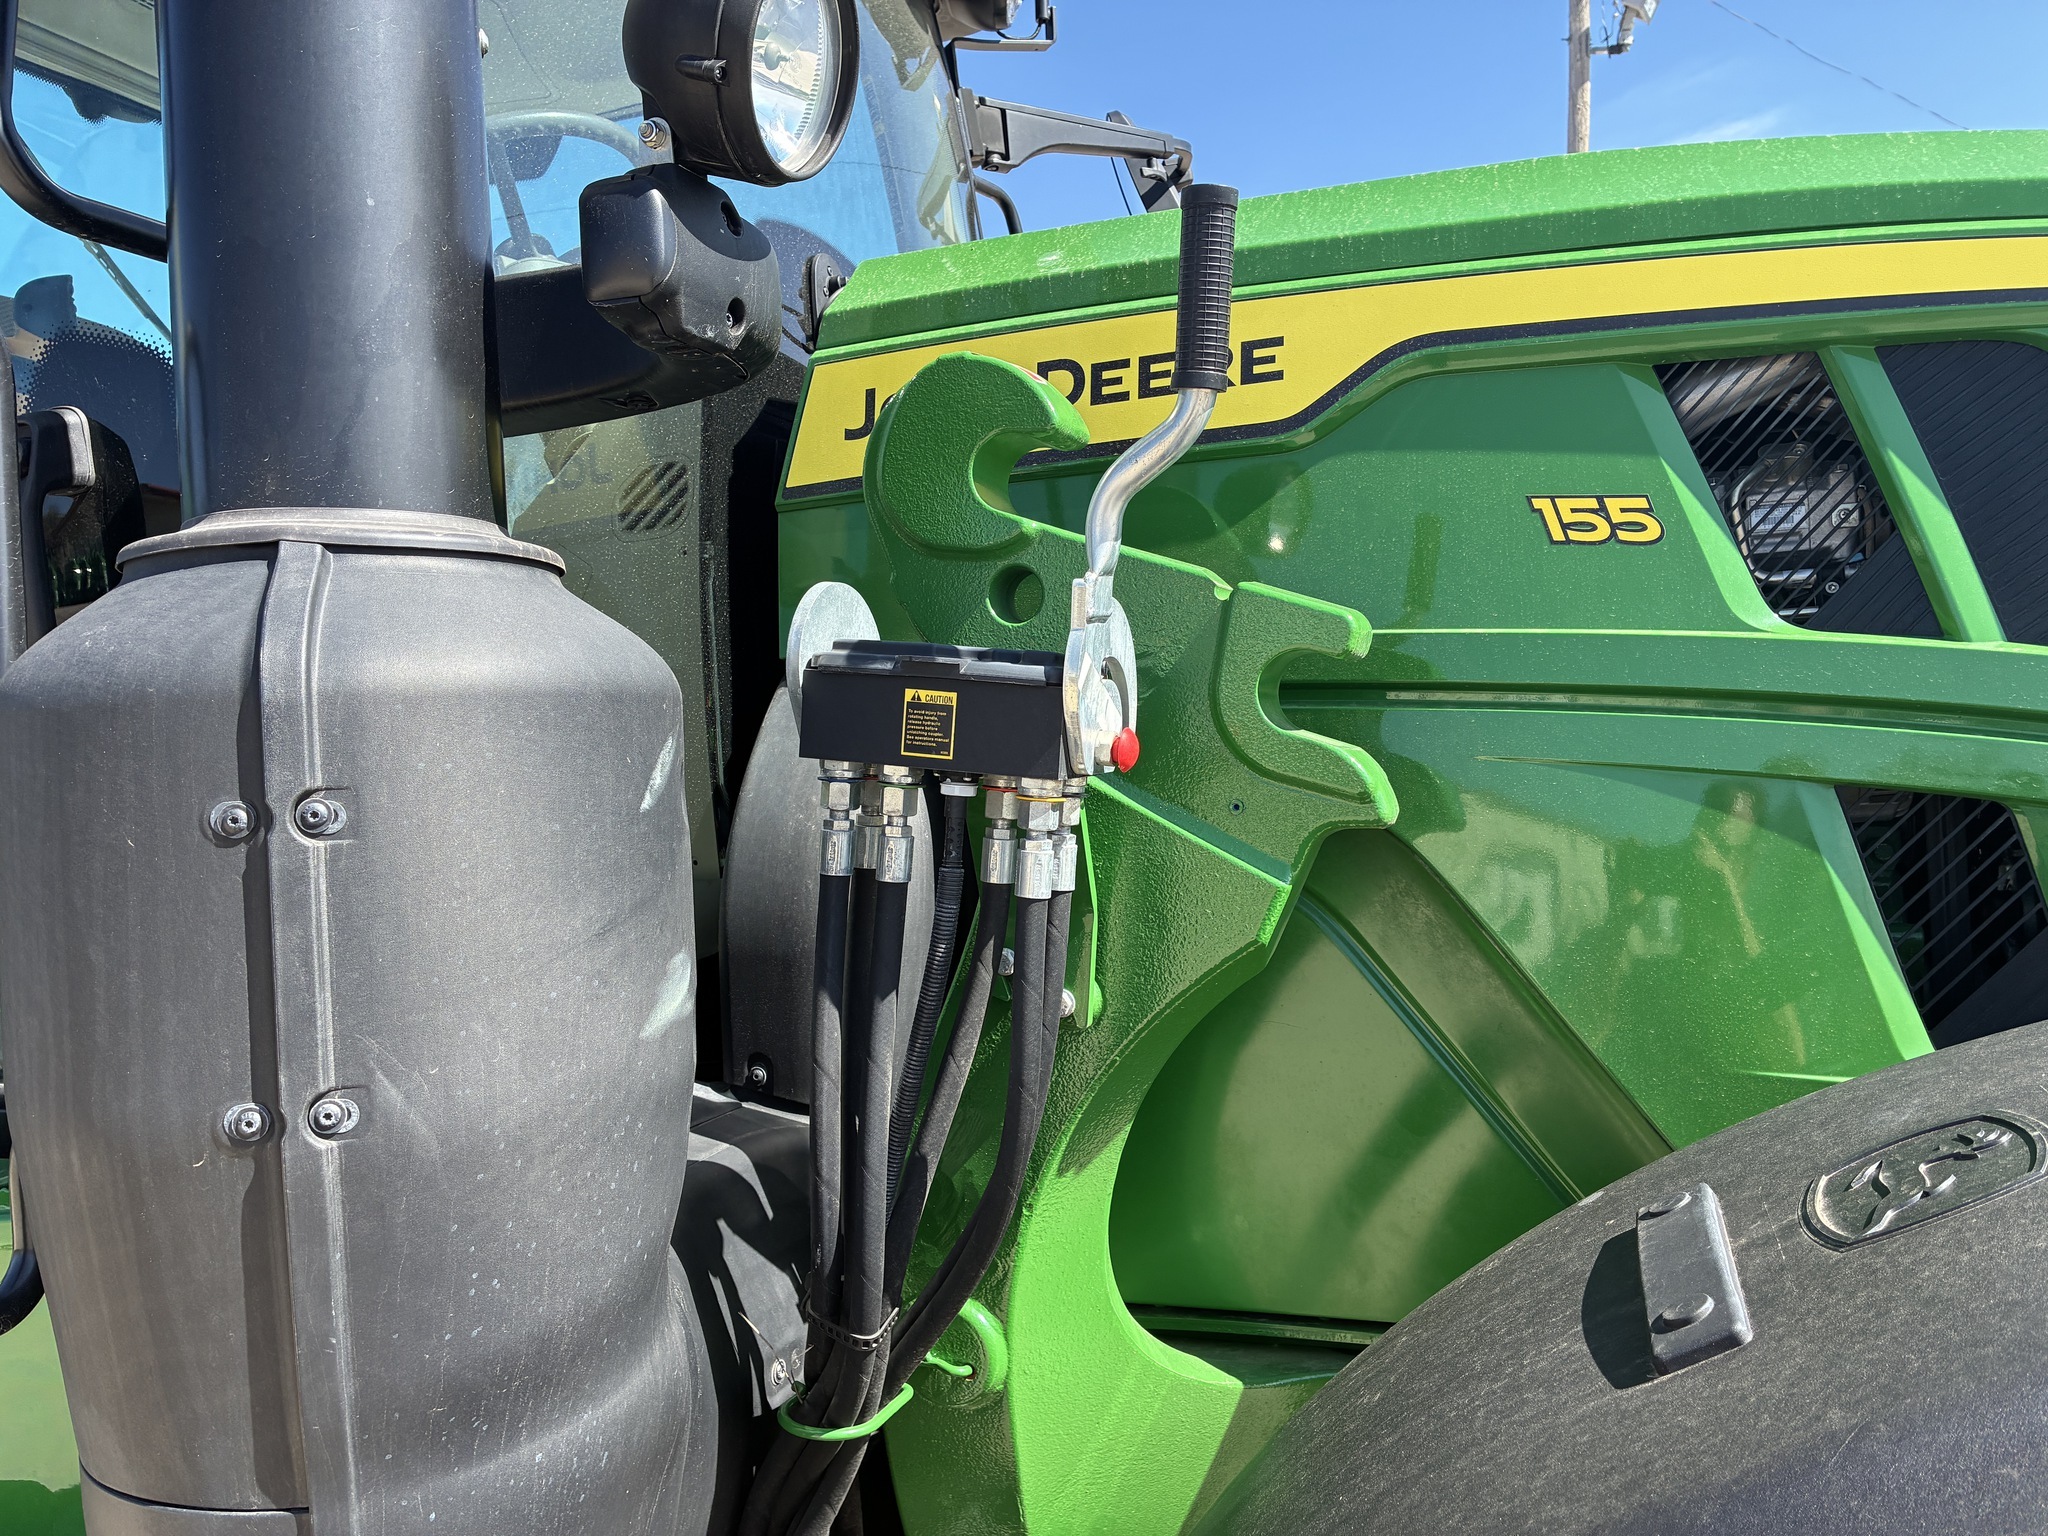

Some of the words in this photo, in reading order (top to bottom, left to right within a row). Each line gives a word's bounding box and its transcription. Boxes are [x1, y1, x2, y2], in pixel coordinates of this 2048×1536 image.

[1037, 336, 1285, 406] DEEE
[1527, 495, 1665, 545] 155
[925, 694, 954, 704] CAUTION
